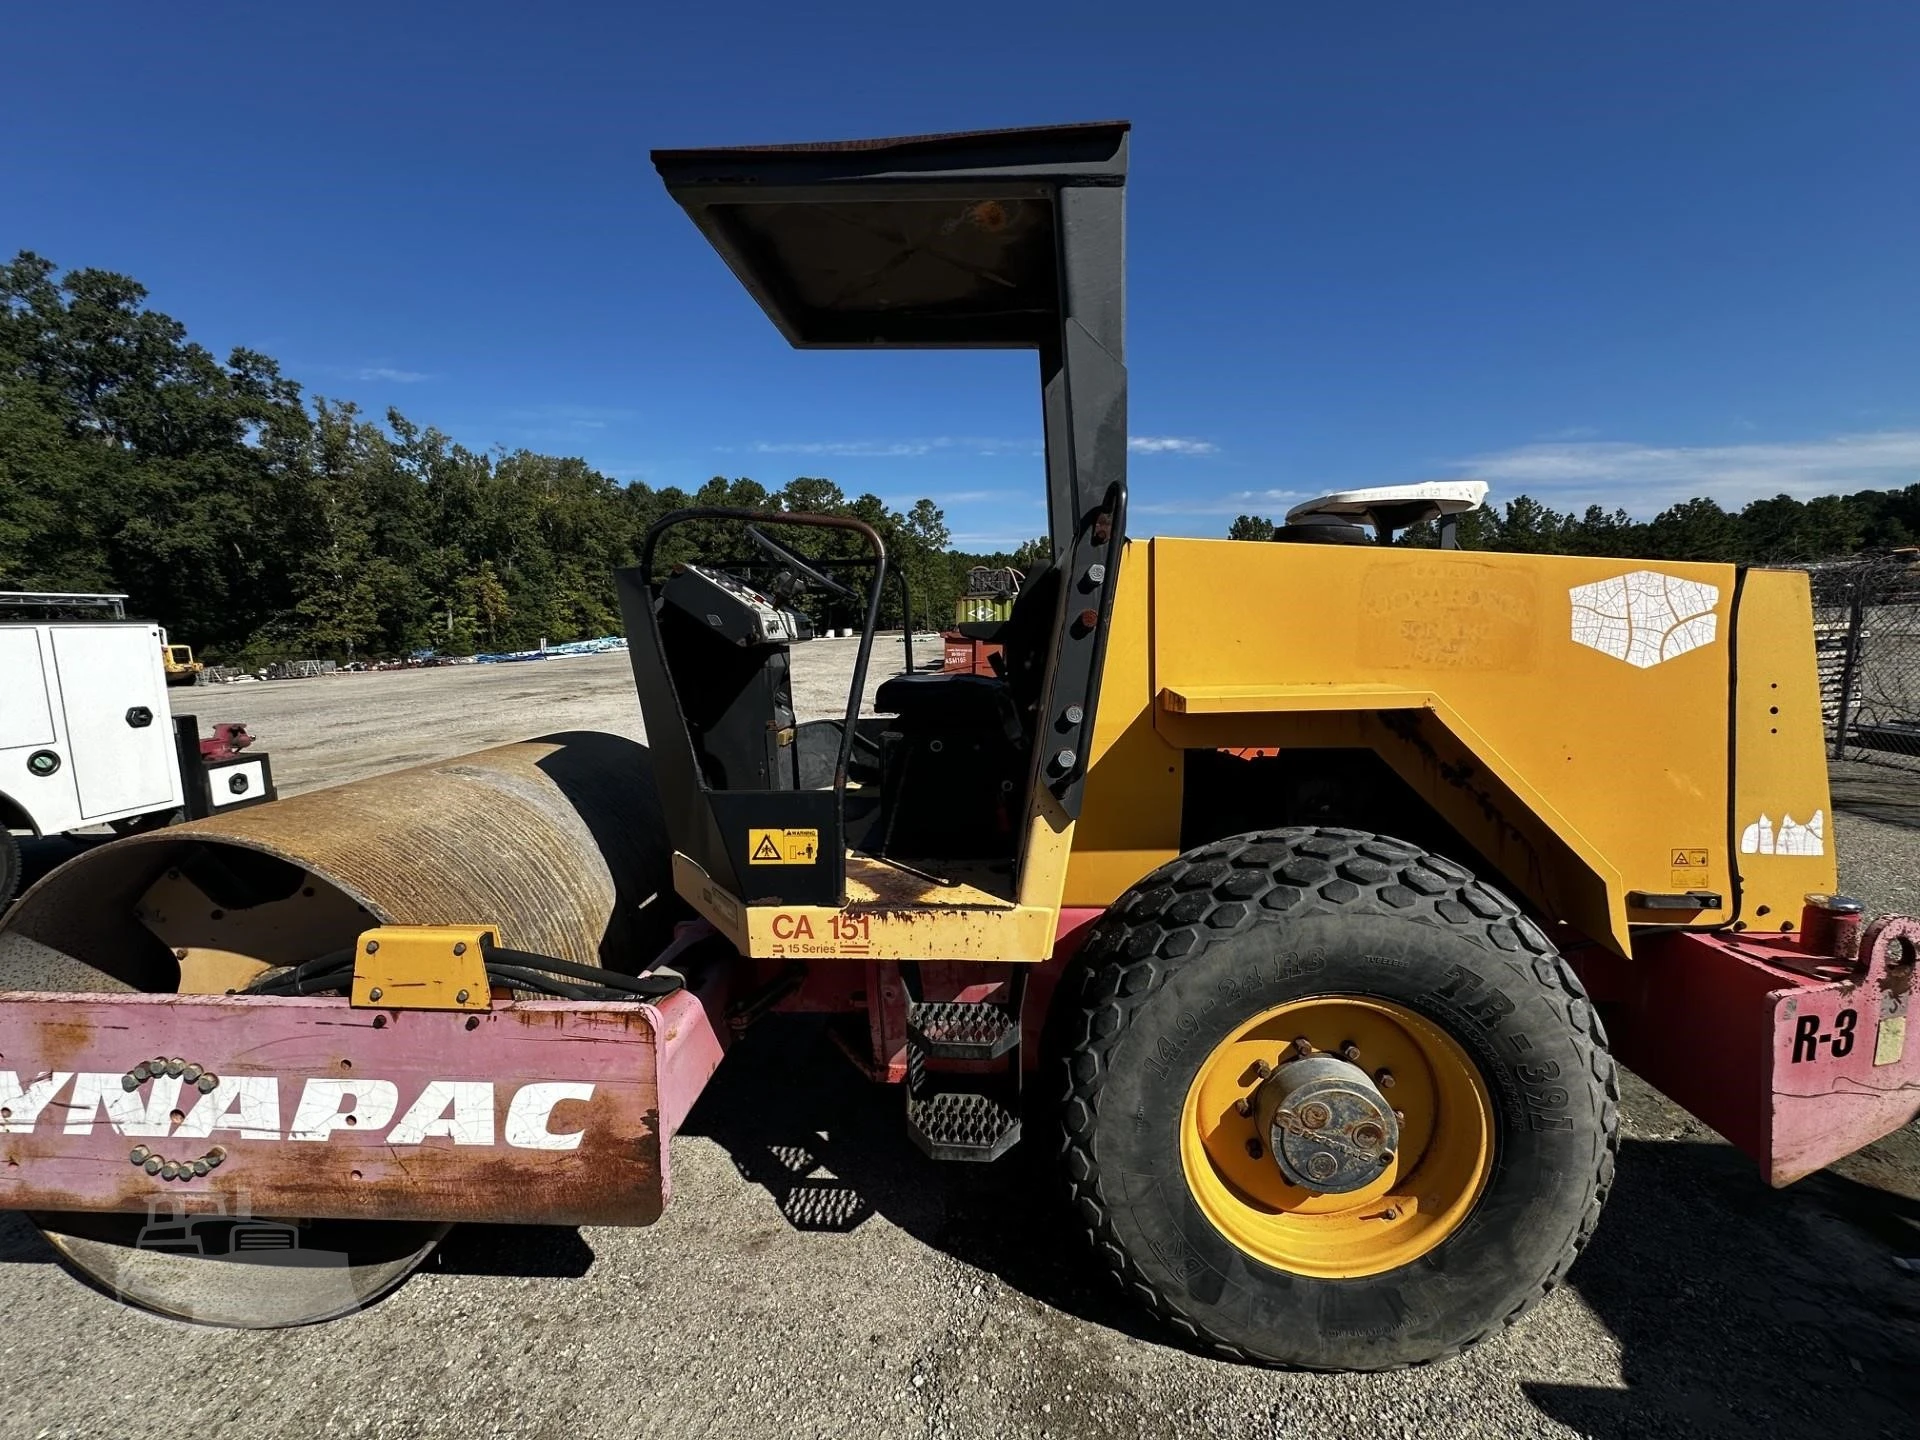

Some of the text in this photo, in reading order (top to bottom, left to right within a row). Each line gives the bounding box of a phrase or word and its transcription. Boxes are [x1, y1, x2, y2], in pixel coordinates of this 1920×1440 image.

[772, 914, 869, 940] CA 151
[788, 944, 836, 953] 15 Series
[1792, 1008, 1858, 1064] R-3
